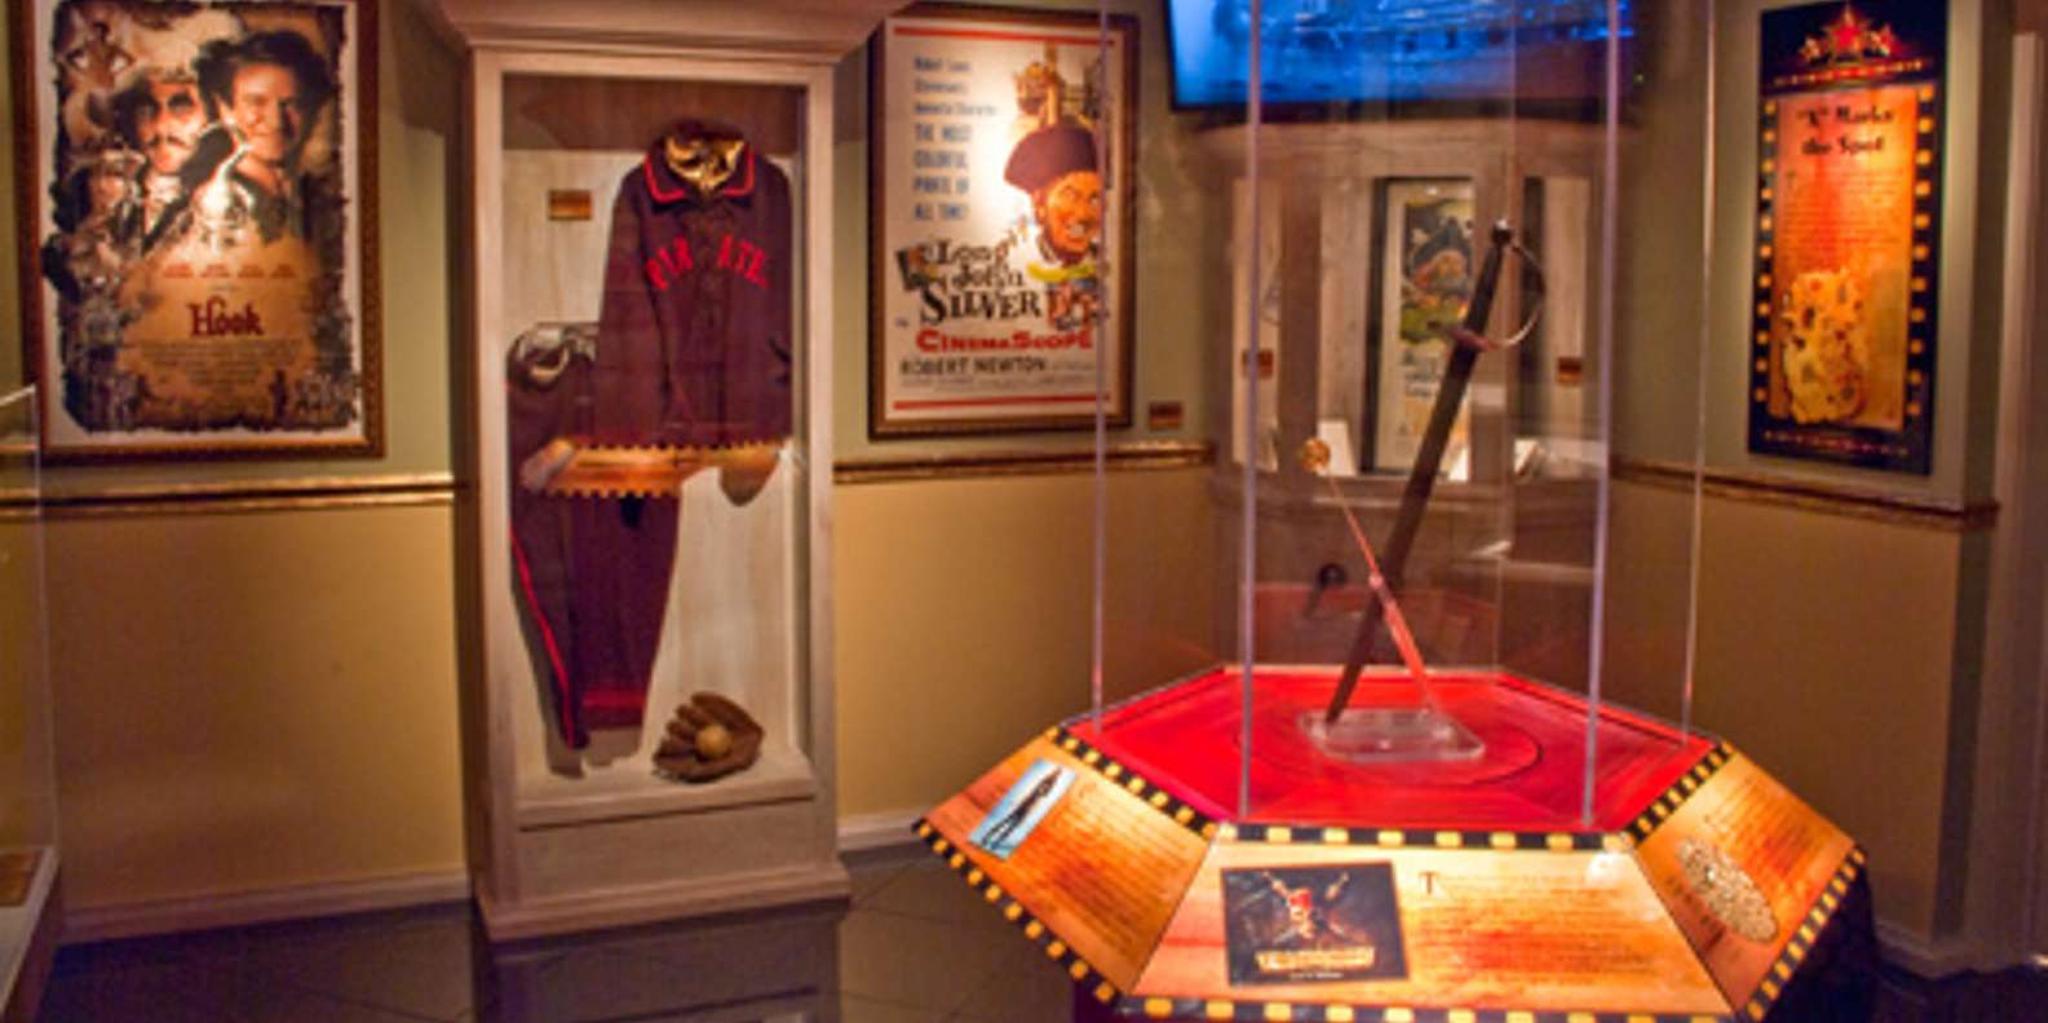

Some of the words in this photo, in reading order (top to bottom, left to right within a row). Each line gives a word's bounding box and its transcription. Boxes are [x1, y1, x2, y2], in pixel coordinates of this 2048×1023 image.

[186, 295, 264, 336] Hook
[901, 357, 968, 375] ROBERT
[974, 356, 1046, 373] NEWTON
